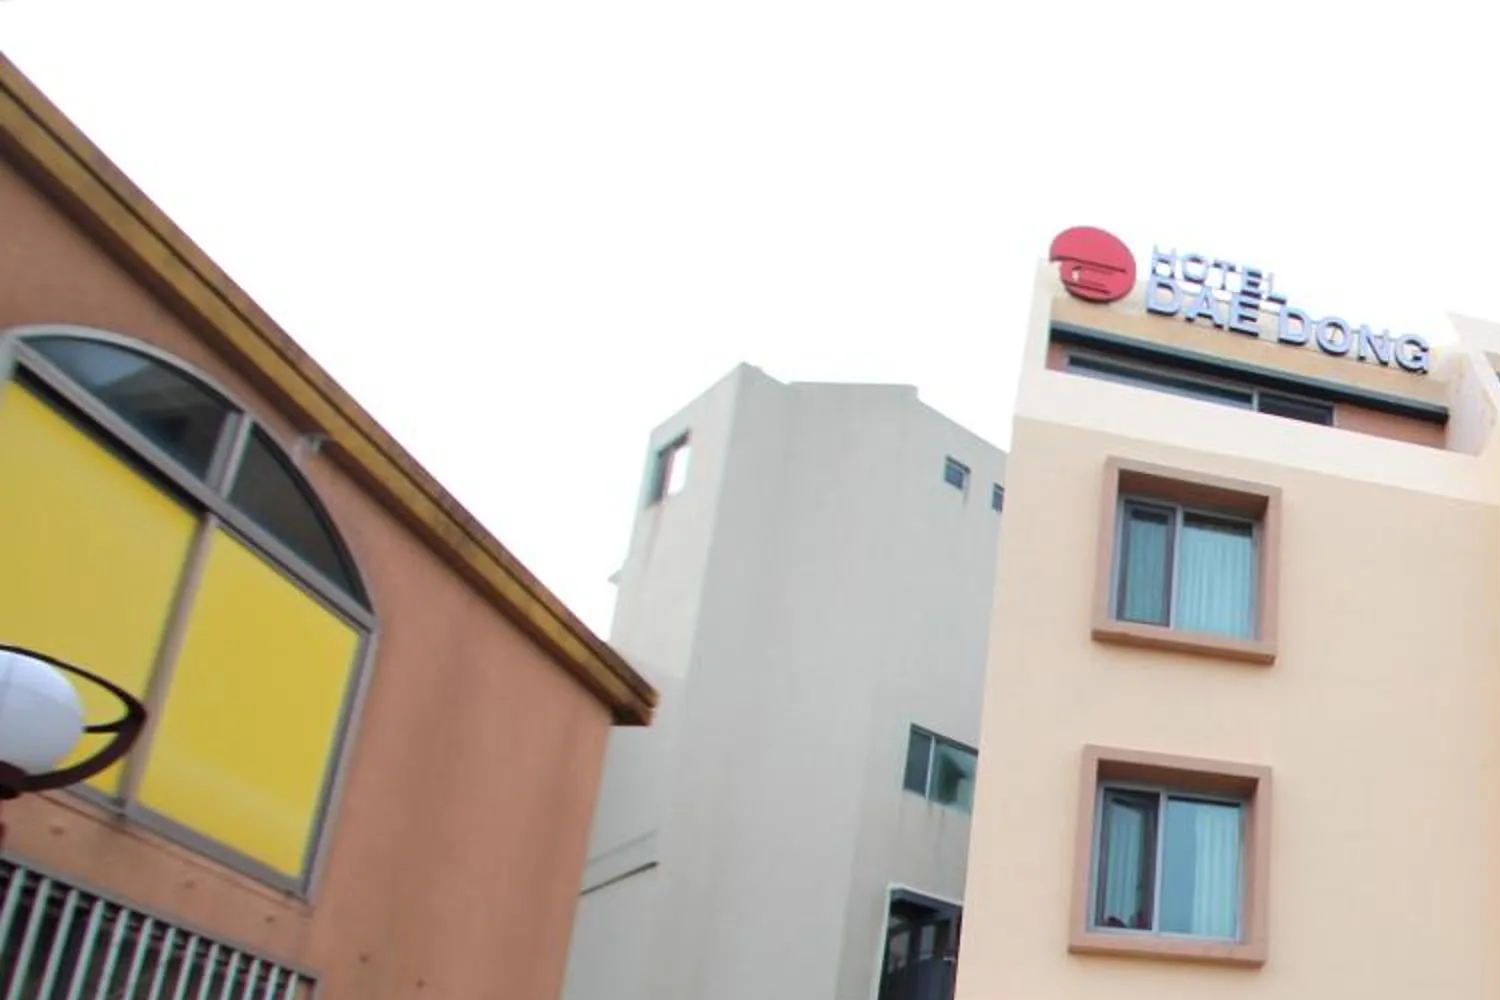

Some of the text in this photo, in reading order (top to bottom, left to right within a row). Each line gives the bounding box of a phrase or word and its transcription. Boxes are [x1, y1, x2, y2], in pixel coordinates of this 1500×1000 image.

[1151, 245, 1287, 305] HOTEL
[1146, 278, 1431, 375] DAE DONG
